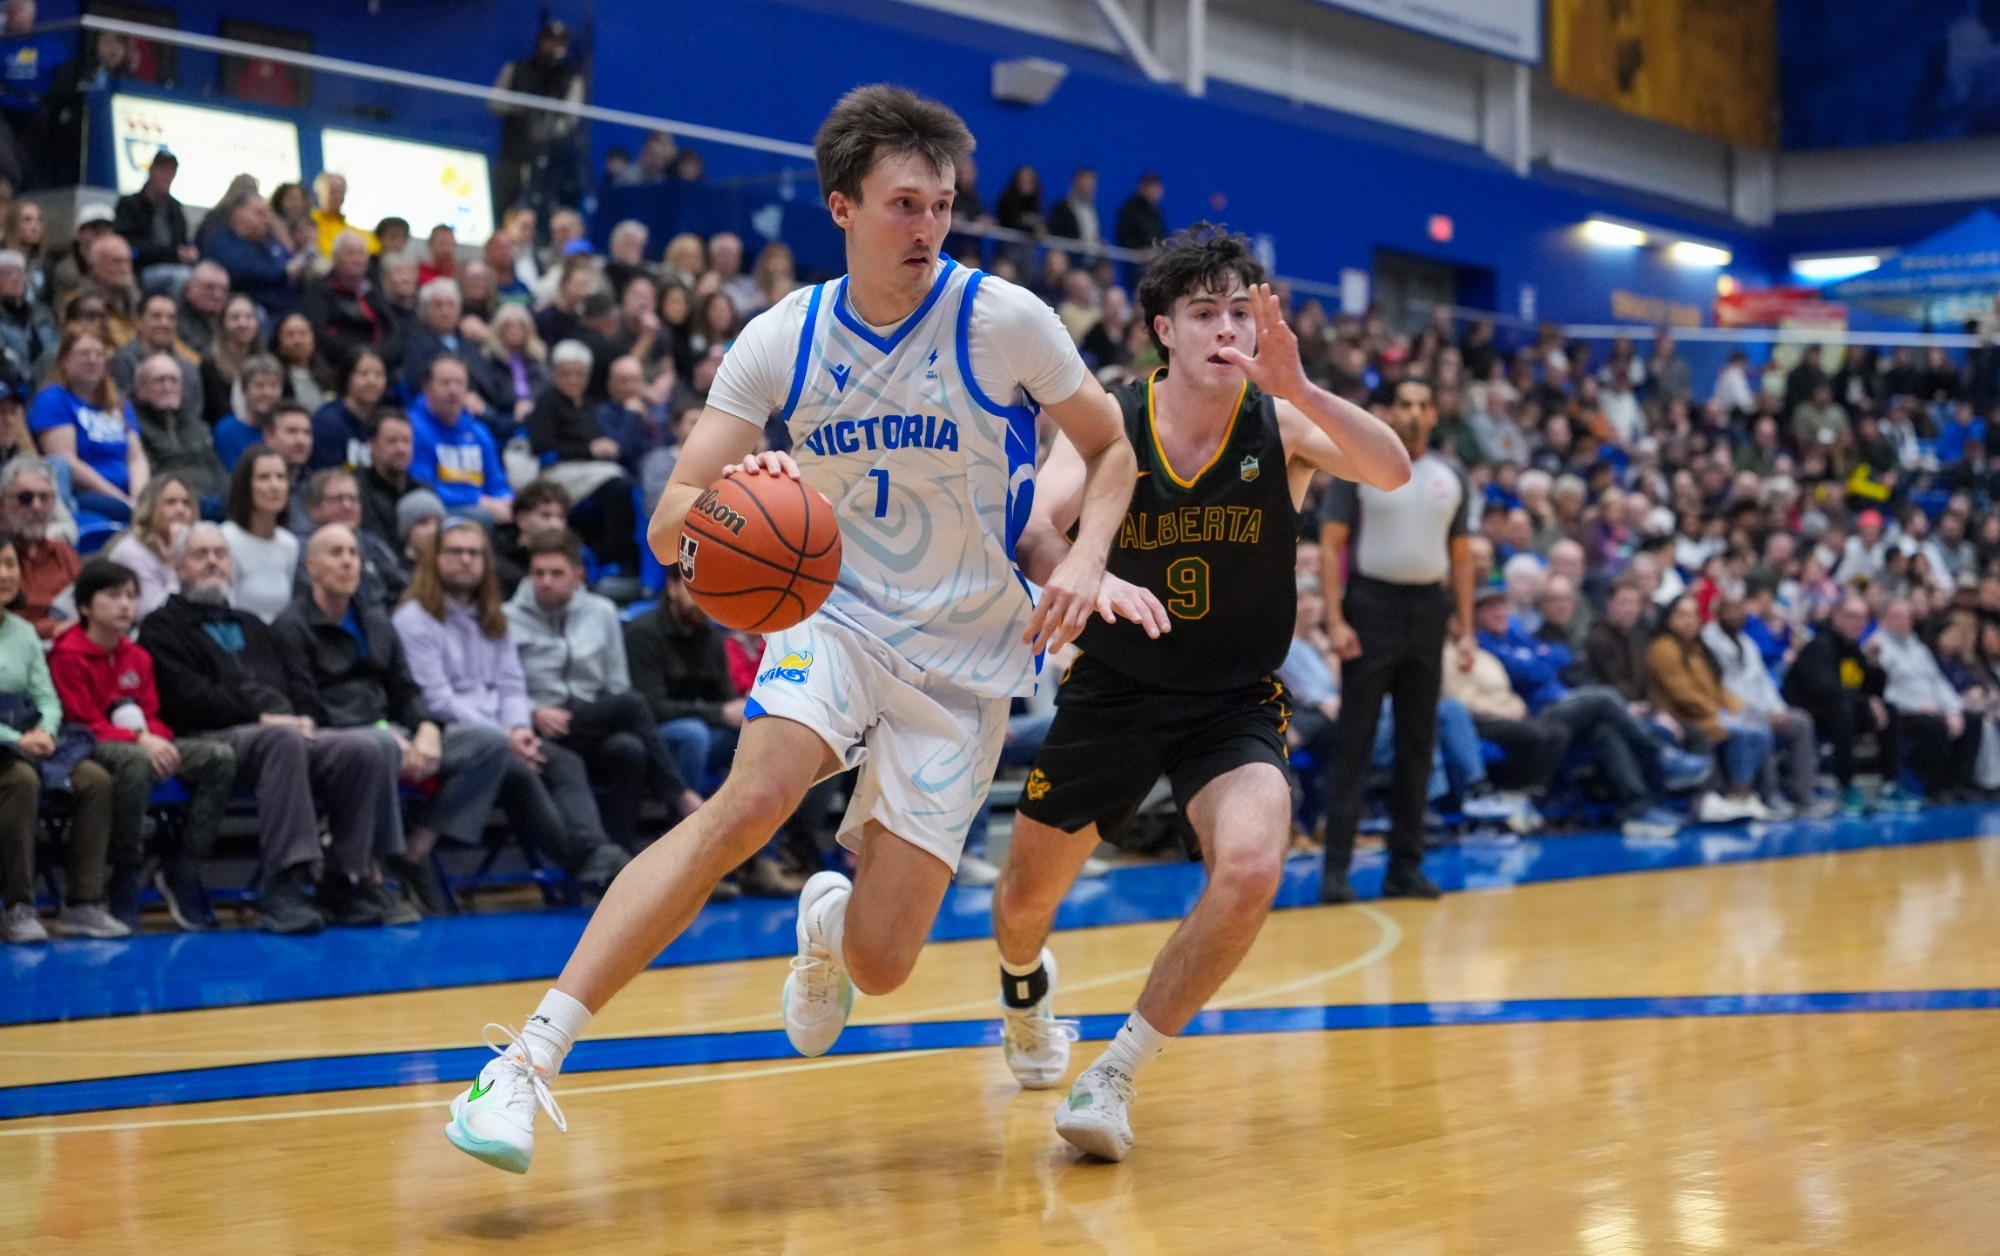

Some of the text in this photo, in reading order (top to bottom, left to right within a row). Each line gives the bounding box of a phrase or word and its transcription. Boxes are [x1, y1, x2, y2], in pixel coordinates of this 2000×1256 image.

[805, 414, 959, 456] VICTORIA
[868, 468, 890, 518] 1
[1120, 505, 1262, 549] ALBERTA
[1167, 556, 1210, 620] 9
